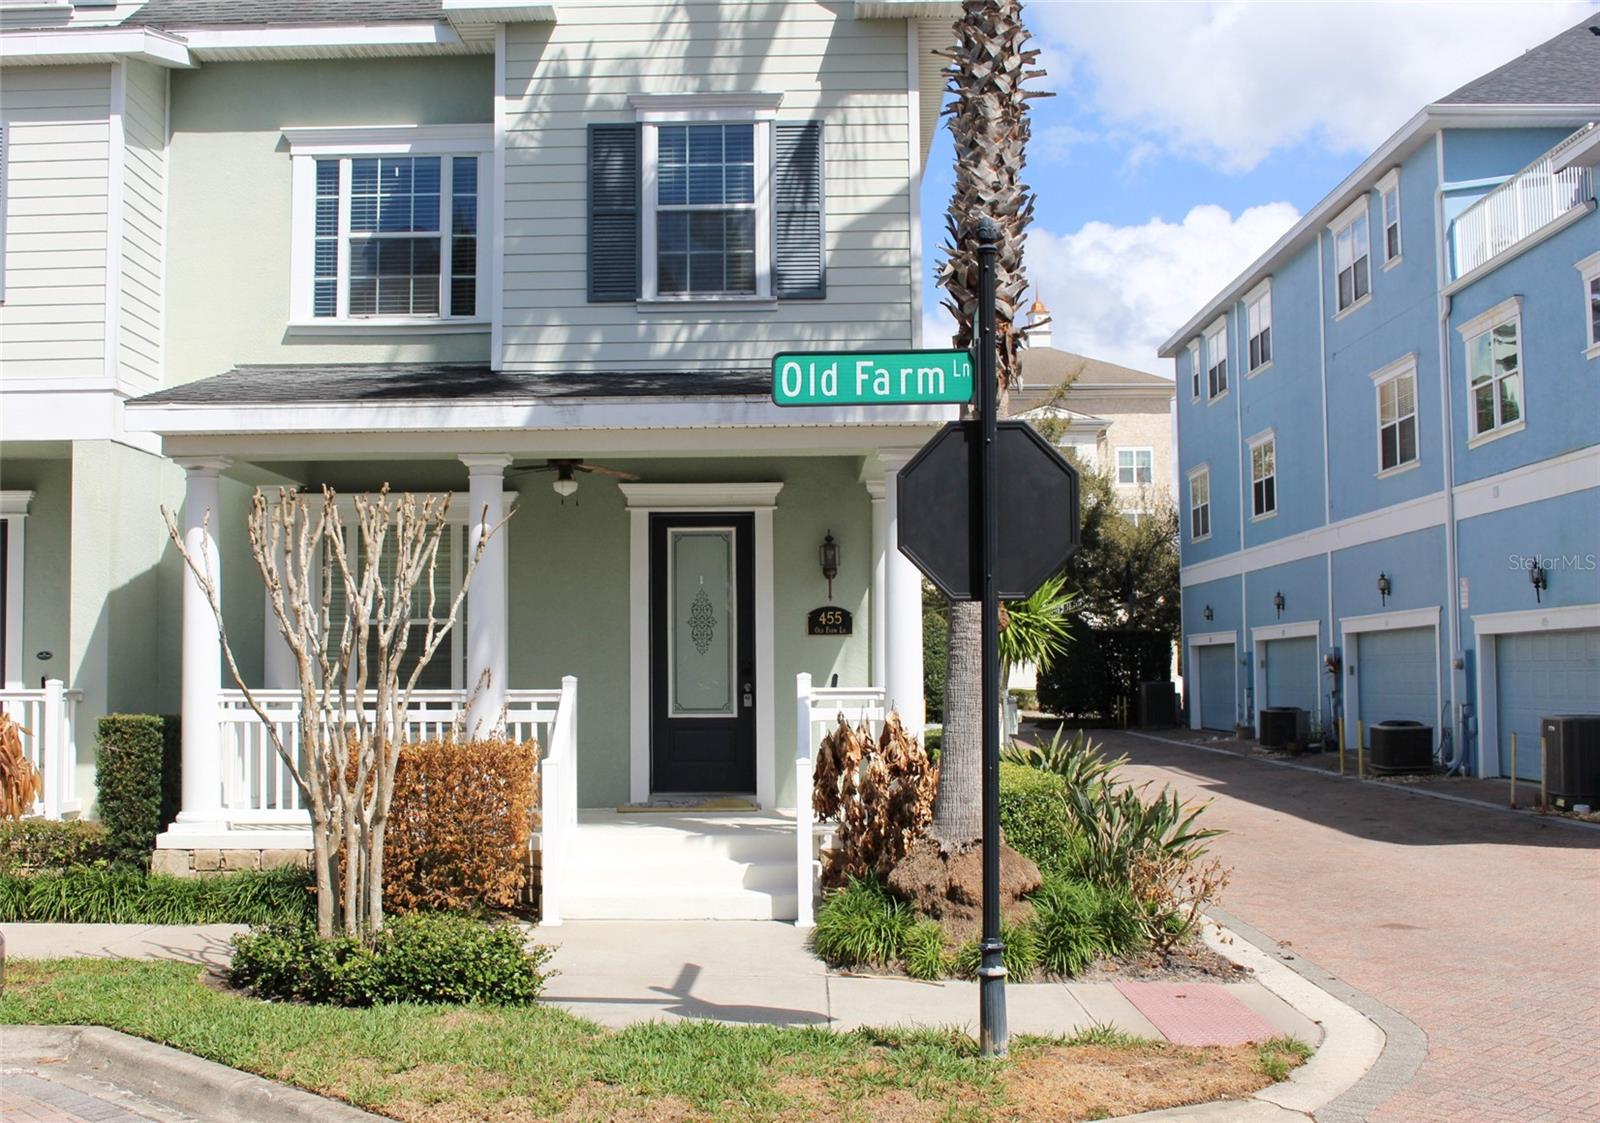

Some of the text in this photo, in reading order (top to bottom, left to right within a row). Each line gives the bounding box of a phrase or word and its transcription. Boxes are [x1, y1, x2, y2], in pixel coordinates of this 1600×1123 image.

[781, 359, 970, 397] Old Farm Ln
[819, 611, 842, 625] 455
